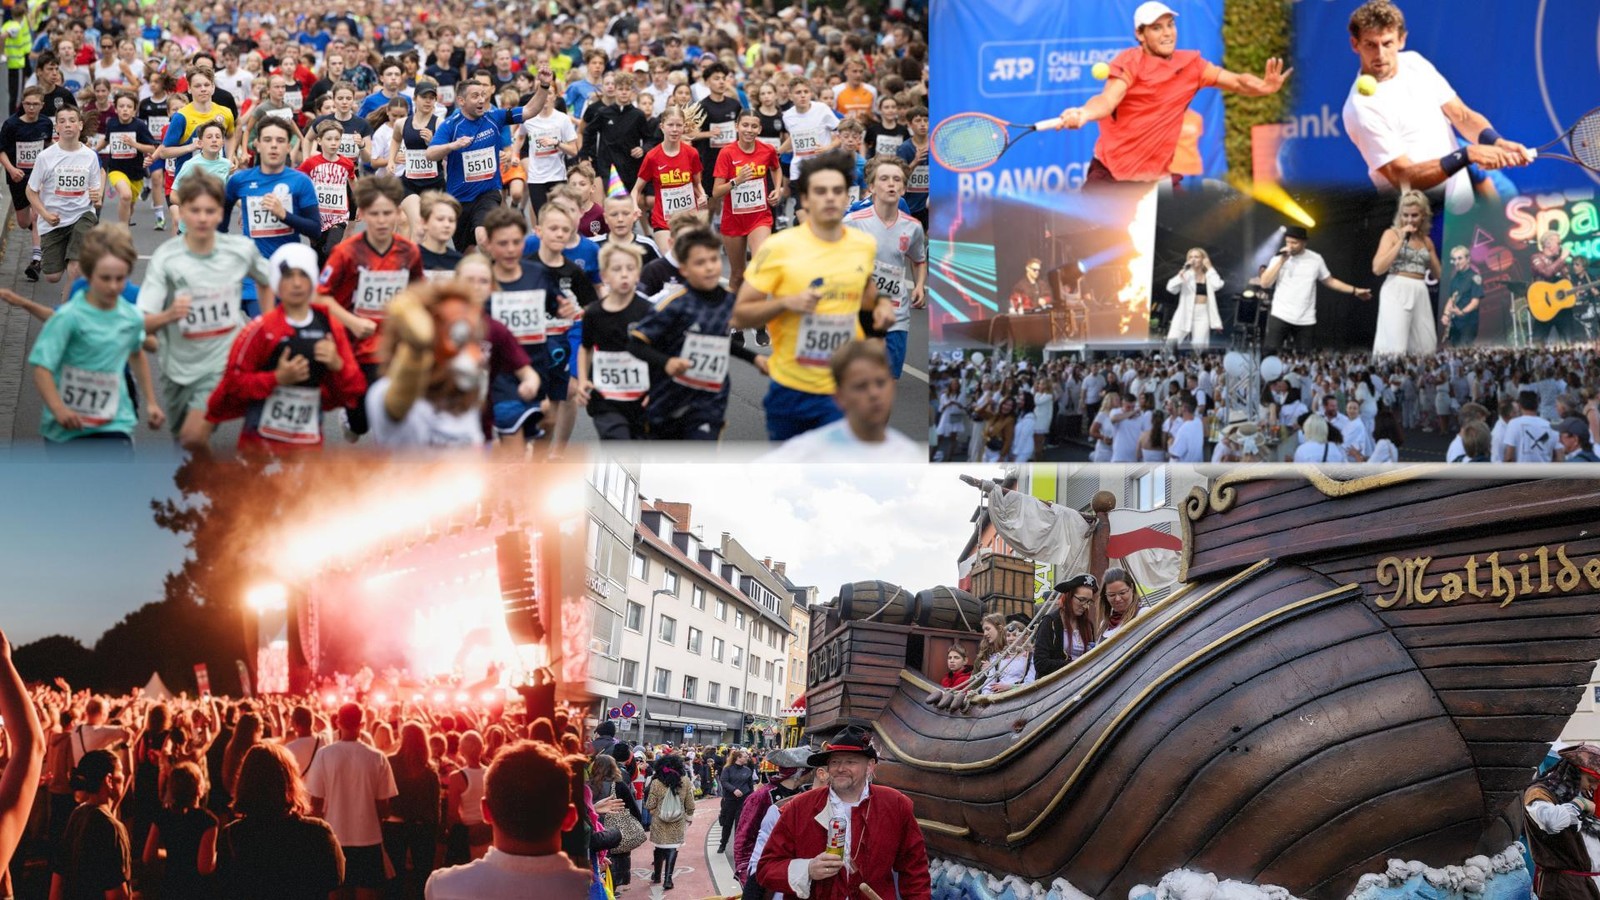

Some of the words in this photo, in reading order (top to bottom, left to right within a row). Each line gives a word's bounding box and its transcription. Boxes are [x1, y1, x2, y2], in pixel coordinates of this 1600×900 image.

[989, 57, 1035, 81] ATP
[1047, 65, 1082, 83] TOUR
[409, 159, 433, 169] 7038
[467, 157, 493, 172] 5510
[58, 175, 85, 187] 5558
[318, 193, 343, 206] 5801
[665, 194, 692, 210] 7035
[735, 189, 762, 204] 7034
[253, 209, 280, 224] 575
[184, 302, 231, 325] 6114
[600, 368, 640, 385] 5511
[62, 385, 112, 410] 5717
[1375, 544, 1600, 608] Mathilde
